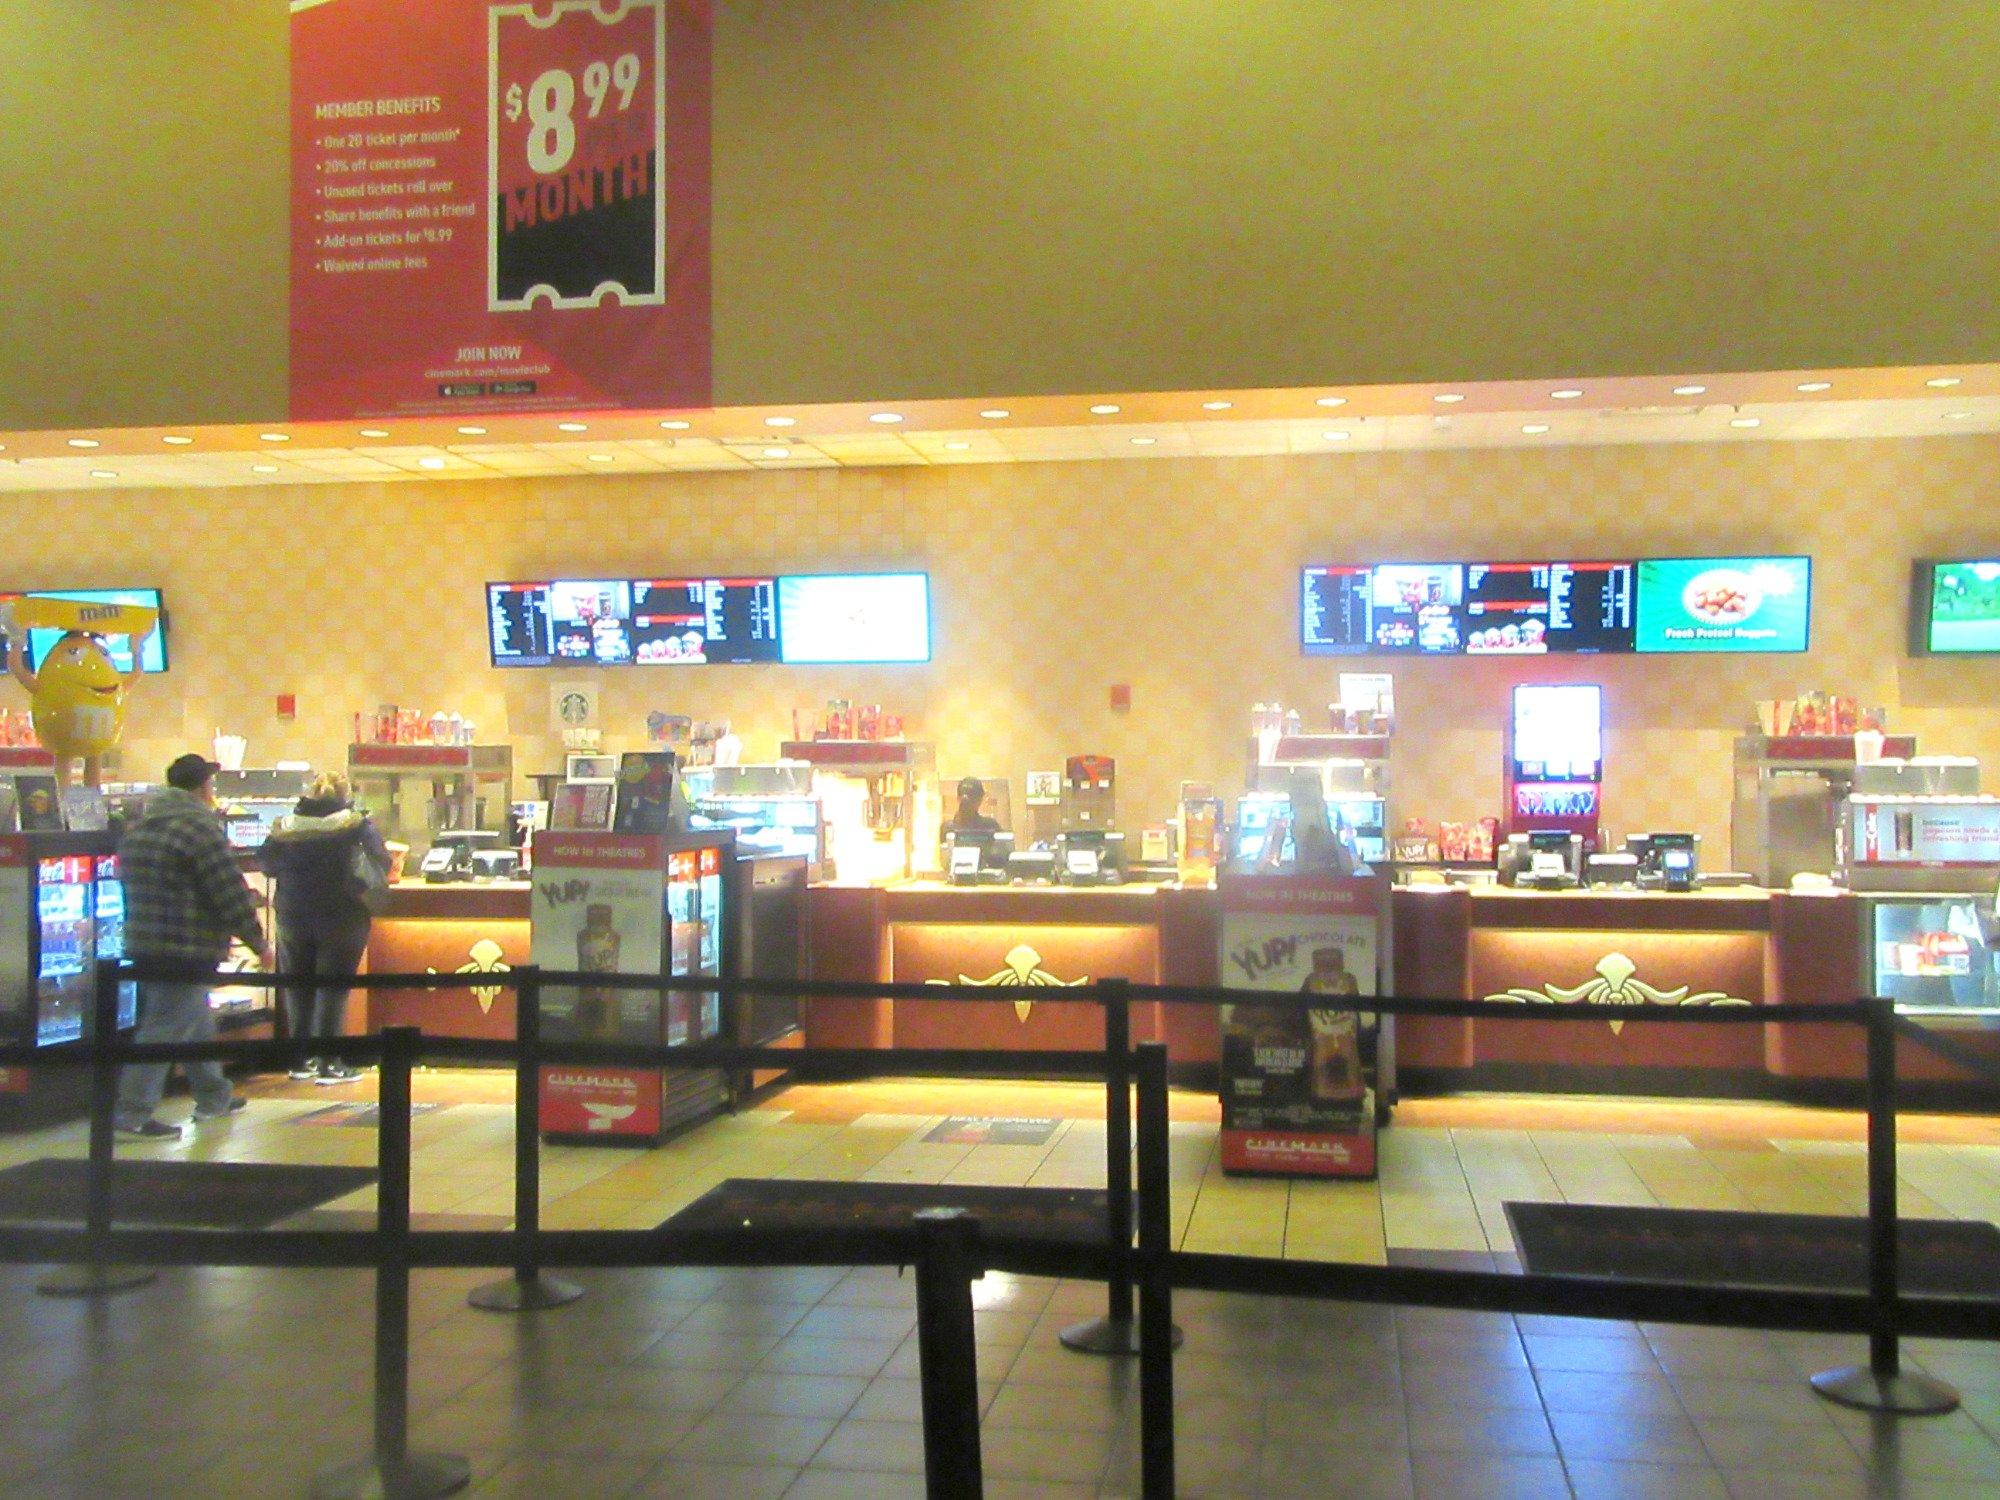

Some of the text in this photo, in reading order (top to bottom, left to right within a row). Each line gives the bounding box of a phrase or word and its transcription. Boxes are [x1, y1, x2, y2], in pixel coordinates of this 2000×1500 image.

[315, 96, 441, 119] MEMBER BENEFITS
[324, 136, 345, 149] One
[366, 132, 397, 147] ticket
[400, 133, 418, 148] per
[324, 157, 436, 173] 20% off concessions
[324, 180, 453, 199] Unused tickets roll over
[504, 152, 649, 233] MONTH
[324, 202, 475, 223] Share benefits with a friend
[324, 234, 364, 248] Add-on
[365, 231, 403, 246] tickets
[405, 230, 420, 243] for
[324, 256, 428, 272] Waived online fees
[456, 346, 522, 362] JOIN NOW
[424, 364, 551, 379] cinemark.com/movieclub
[553, 846, 580, 856] NOW
[548, 1074, 637, 1089] CINEMARK
[1244, 1138, 1350, 1154] CINEMARK
